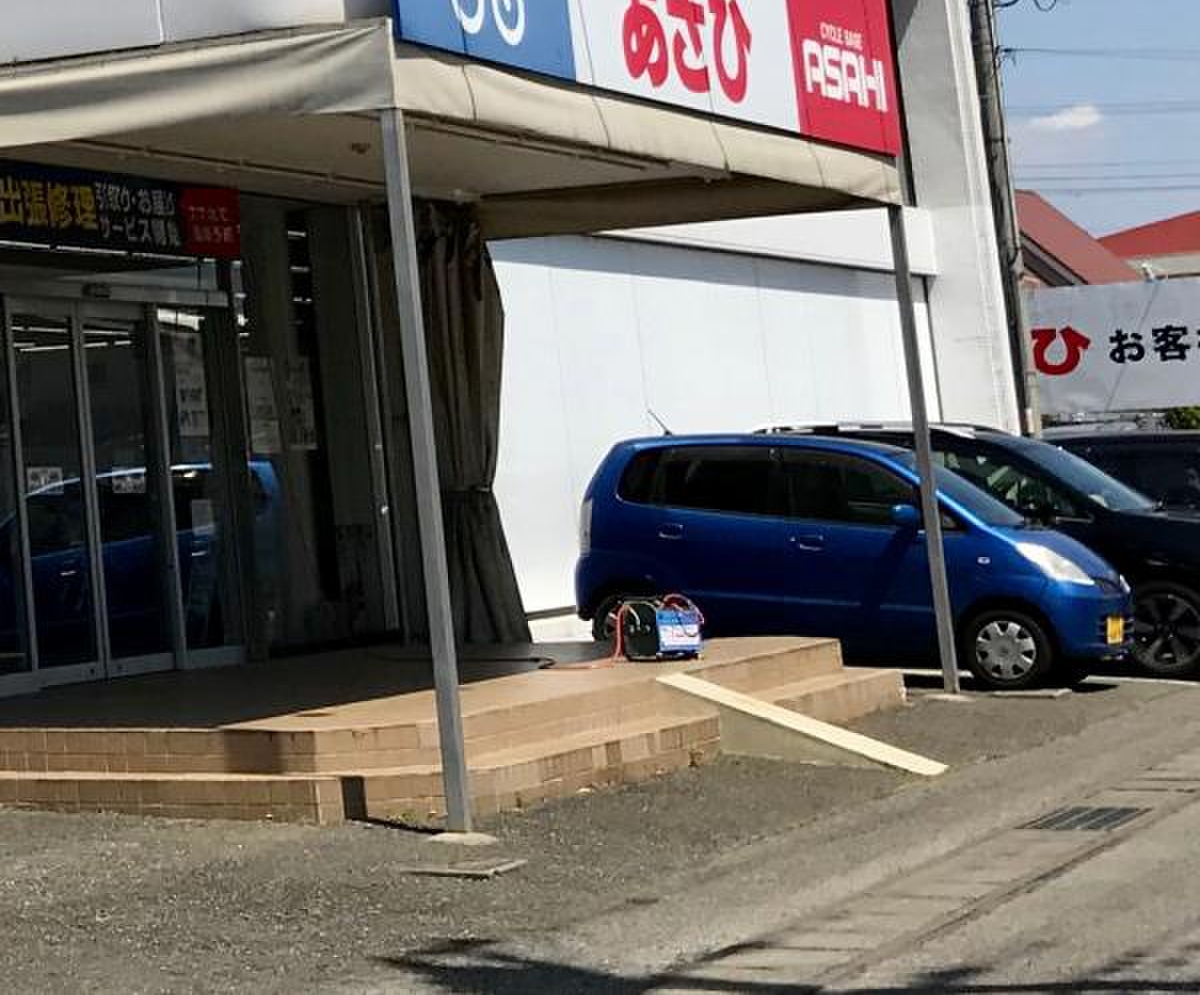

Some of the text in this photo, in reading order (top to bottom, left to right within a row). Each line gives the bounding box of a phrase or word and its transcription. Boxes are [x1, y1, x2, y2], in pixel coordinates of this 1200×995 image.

[802, 38, 888, 113] ASAHI
[1030, 324, 1200, 376] ひ お客
